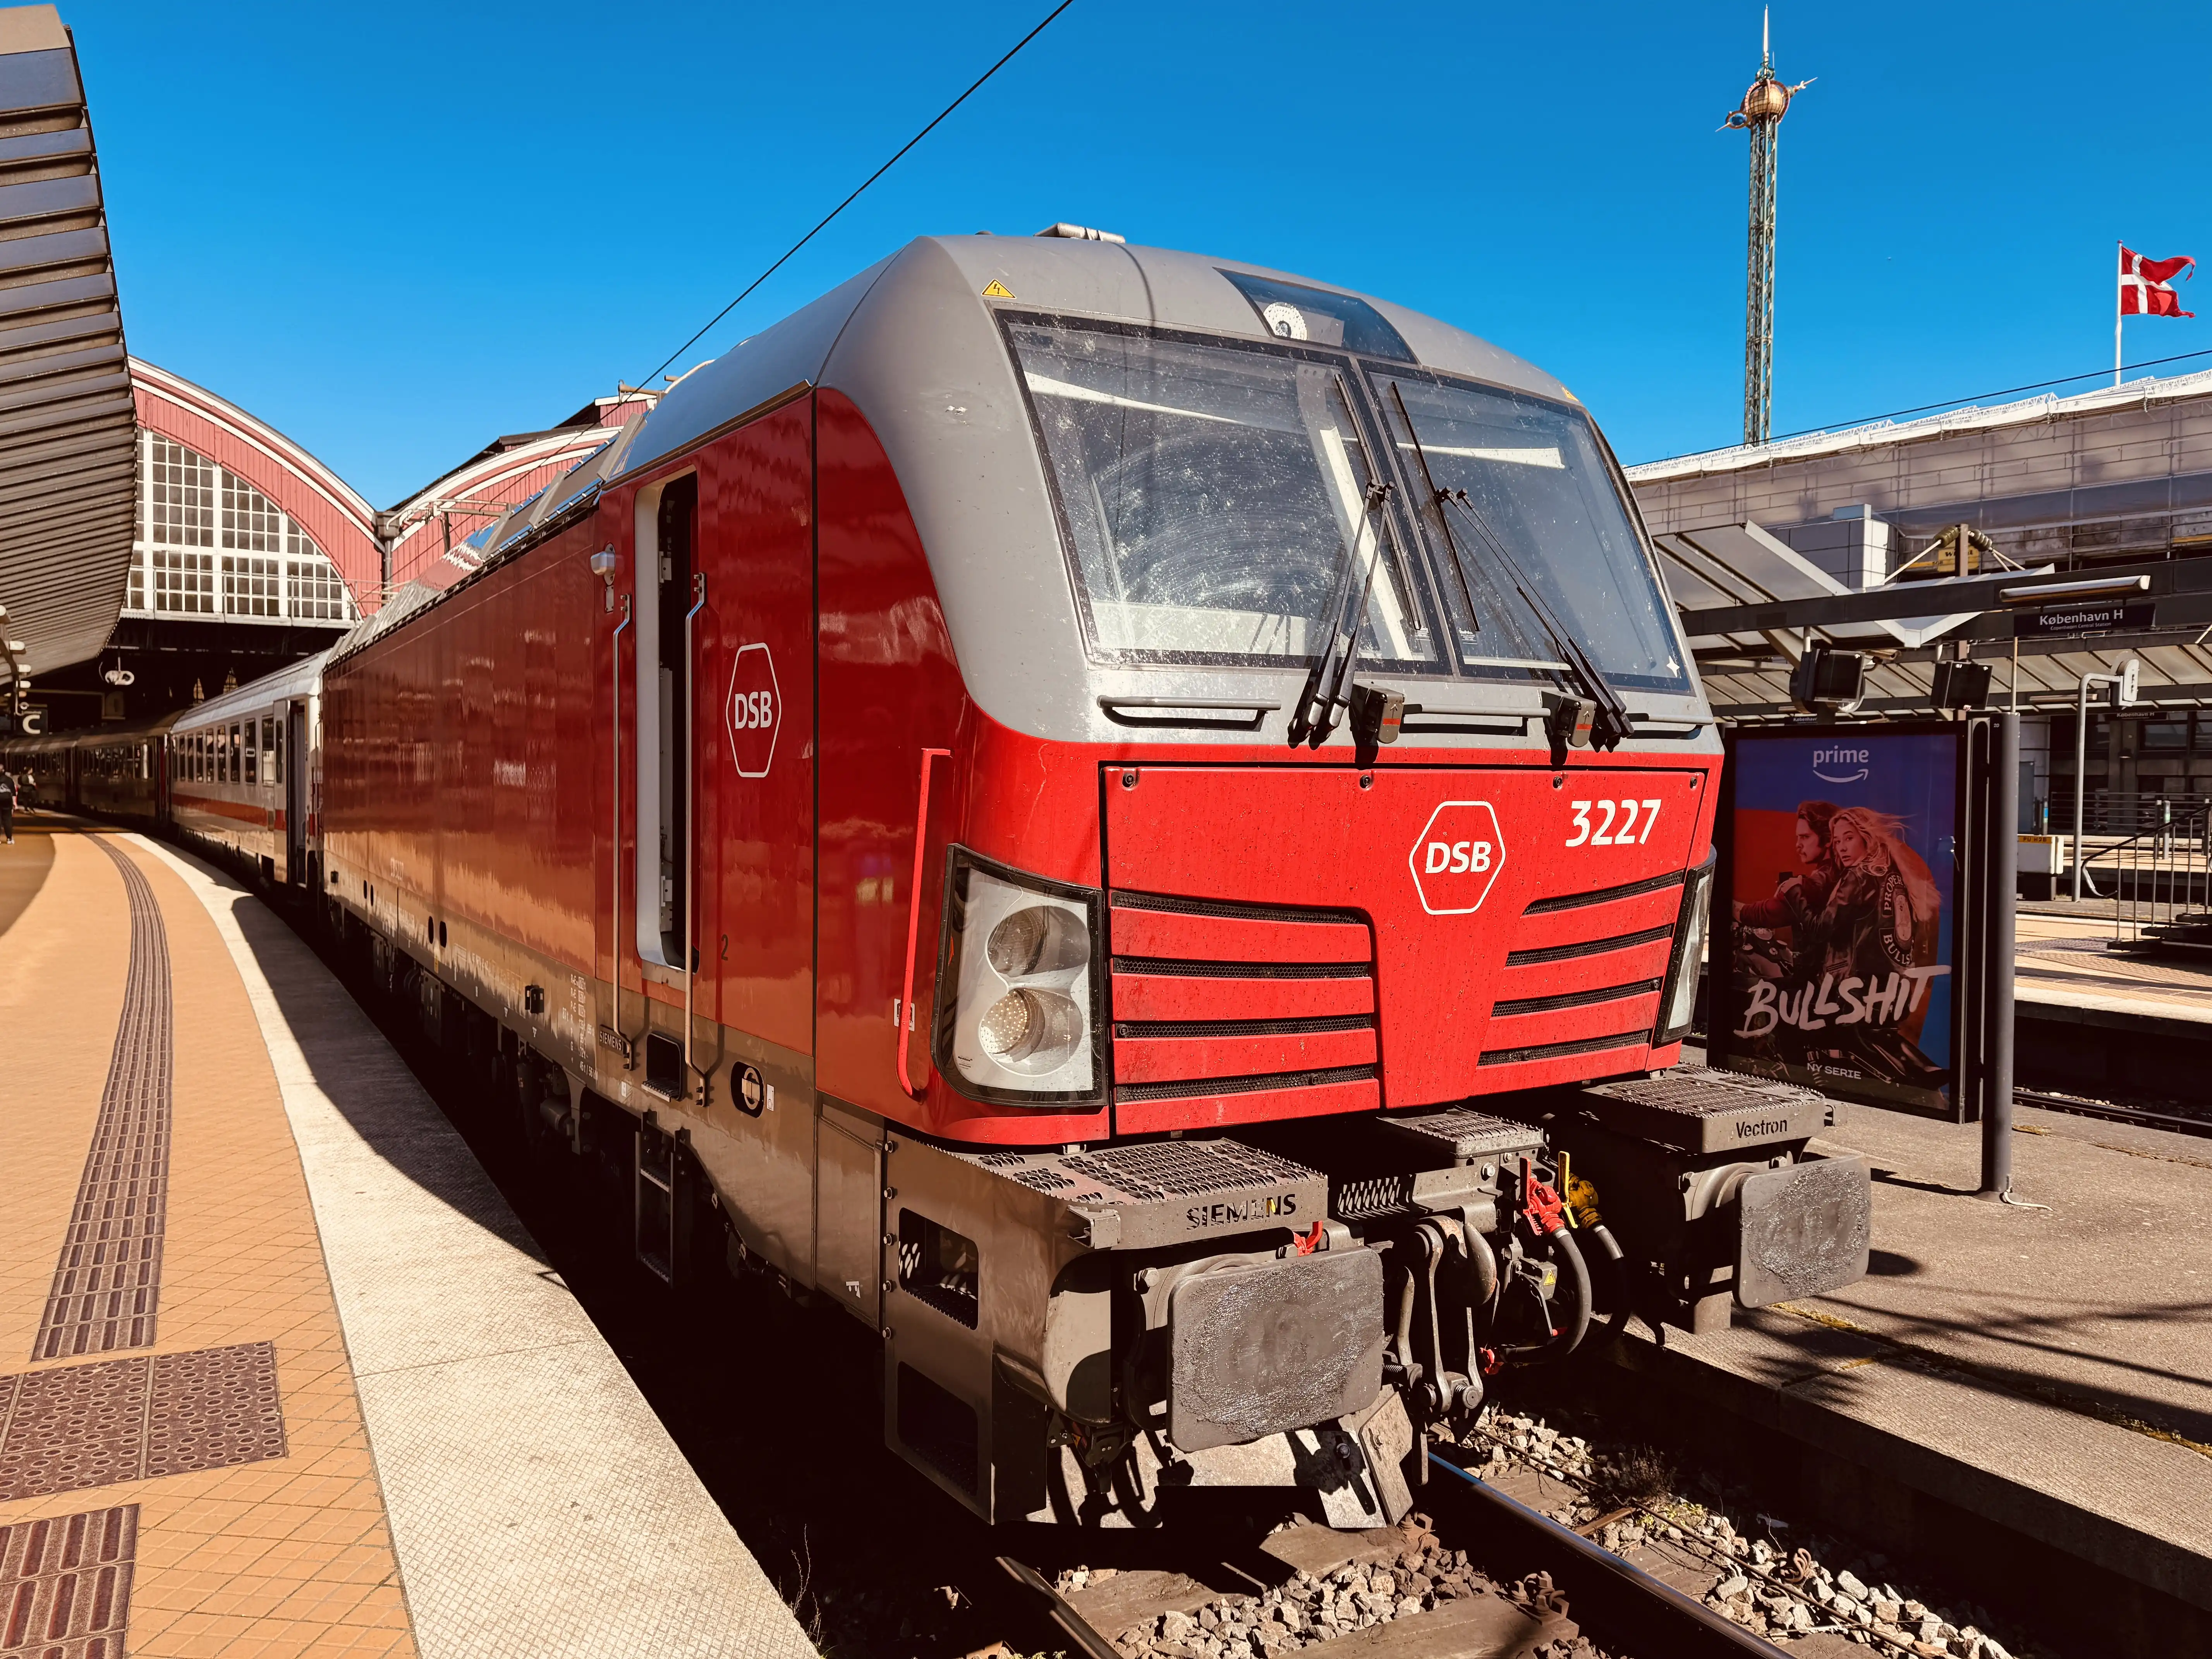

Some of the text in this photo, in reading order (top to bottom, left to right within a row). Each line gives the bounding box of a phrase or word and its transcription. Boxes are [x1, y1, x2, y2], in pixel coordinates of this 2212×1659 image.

[2040, 609, 2123, 625] København H
[22, 714, 40, 734] C
[735, 691, 772, 729] DSB
[1814, 745, 1869, 767] prime
[1565, 799, 1662, 847] 3227
[1425, 841, 1492, 873] DSB
[1884, 875, 1905, 911] PROPER
[721, 934, 728, 961] 2
[1883, 934, 1912, 964] BULLS
[1733, 965, 1952, 1038] BULLSHIT
[599, 1031, 622, 1051] SIEMENS
[1807, 1063, 1862, 1079] NY SERIE
[1736, 1119, 1788, 1139] Vectron
[1186, 1194, 1297, 1230] SIEMENS
